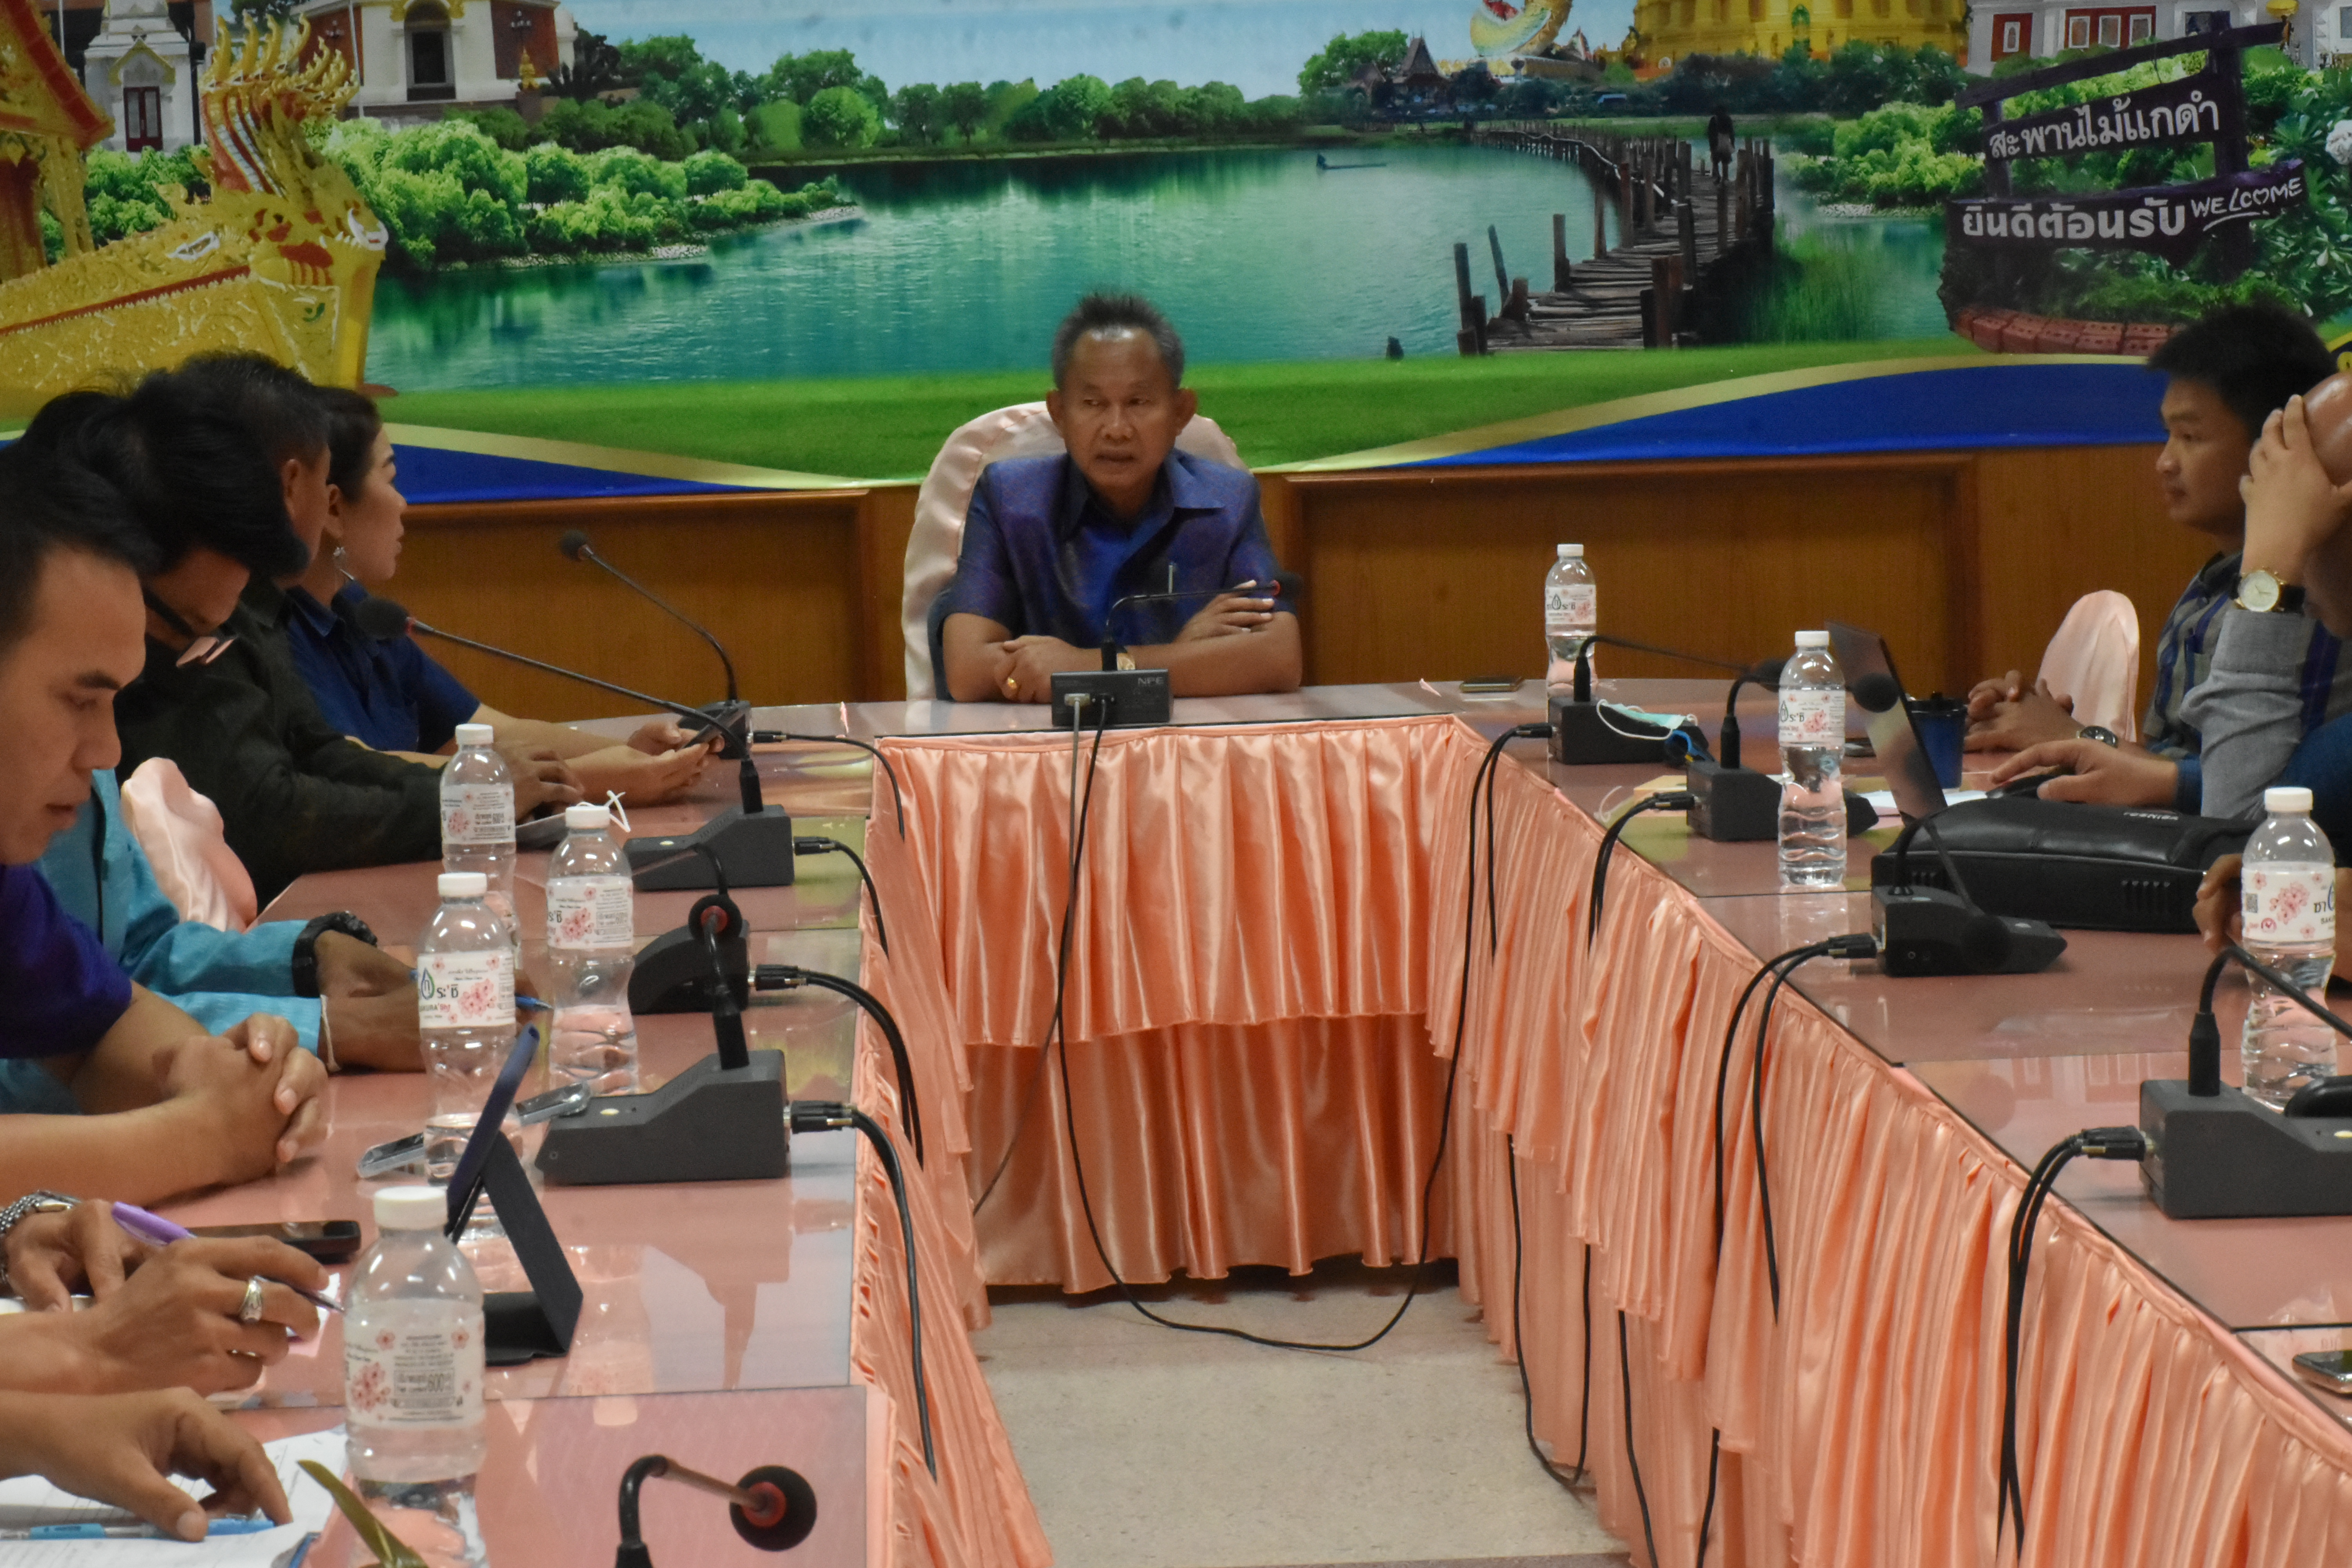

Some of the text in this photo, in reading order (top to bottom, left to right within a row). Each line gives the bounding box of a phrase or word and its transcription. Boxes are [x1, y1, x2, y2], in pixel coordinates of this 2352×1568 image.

[1989, 90, 2219, 158] สะพานไม้แกดำ
[1963, 178, 2303, 238] ยินดีต้อนรับ WELCOME
[1138, 677, 1164, 685] NPE
